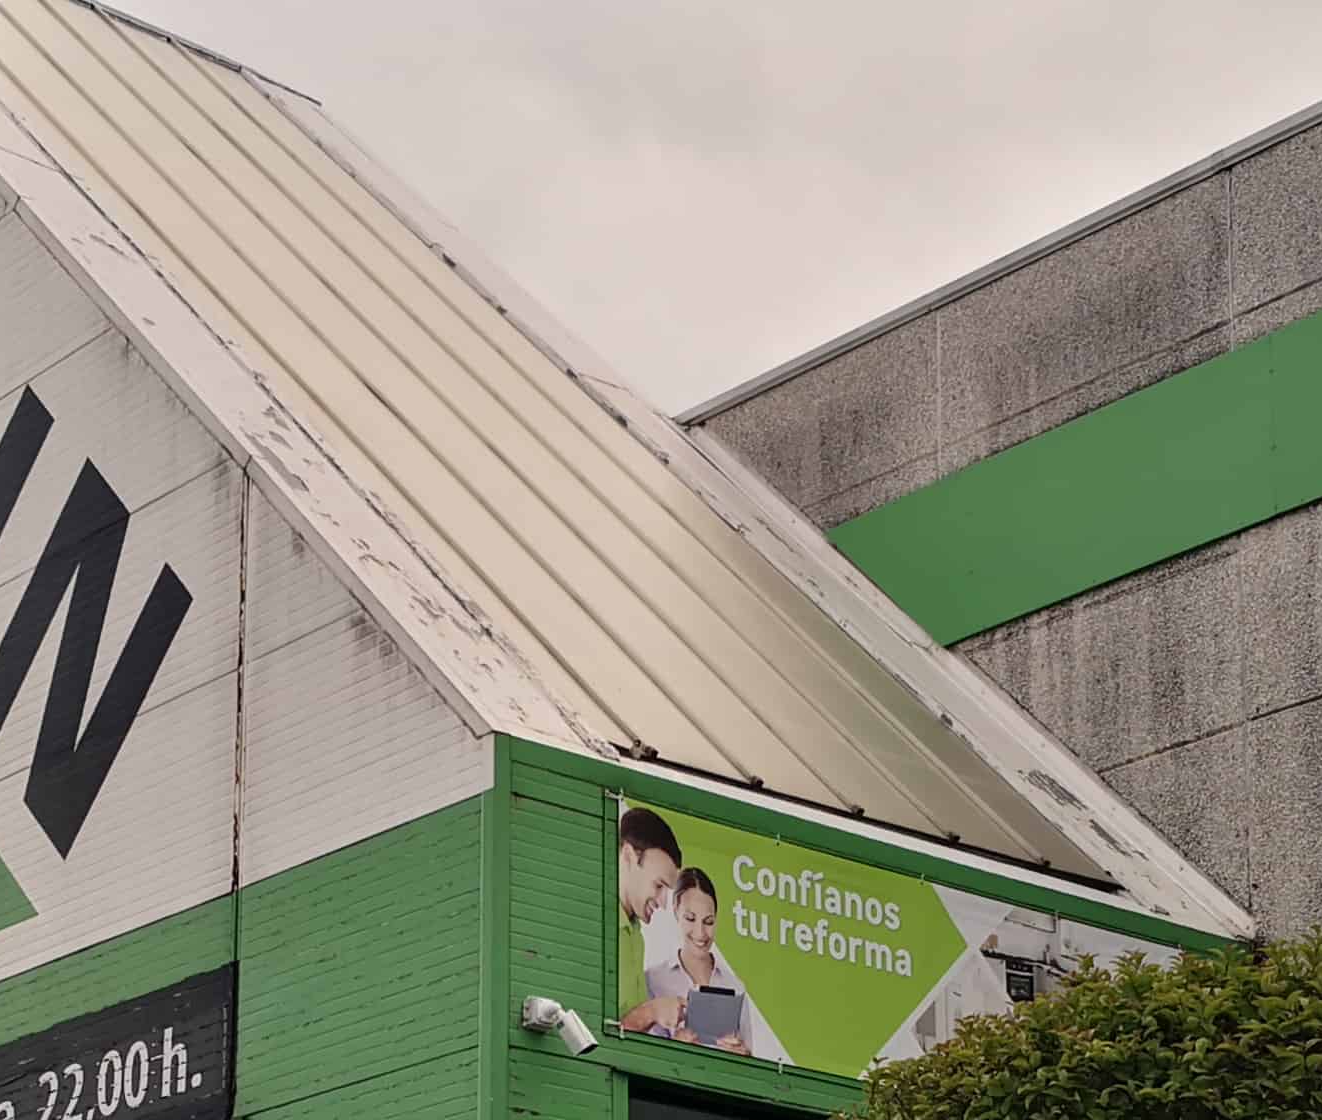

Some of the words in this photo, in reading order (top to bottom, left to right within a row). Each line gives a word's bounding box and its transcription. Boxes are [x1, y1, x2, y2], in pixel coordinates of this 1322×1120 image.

[732, 855, 901, 930] Confíanos
[732, 900, 769, 941] tu
[779, 919, 912, 977] reforma
[161, 1027, 203, 1098] h.
